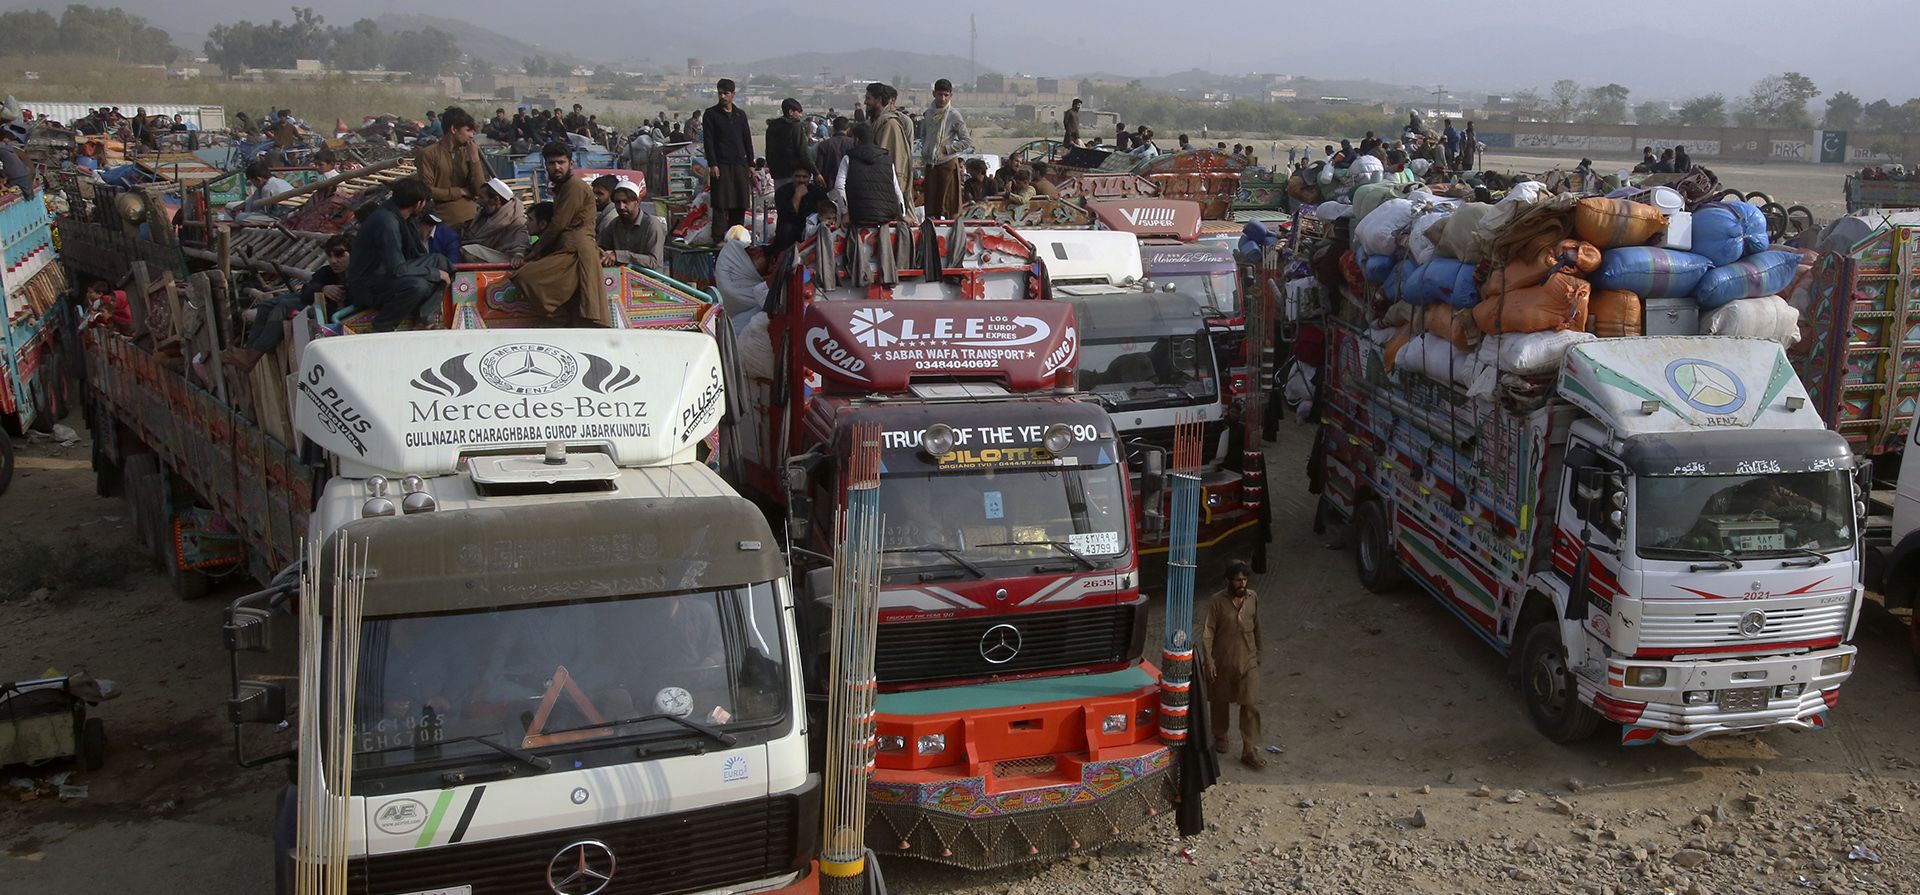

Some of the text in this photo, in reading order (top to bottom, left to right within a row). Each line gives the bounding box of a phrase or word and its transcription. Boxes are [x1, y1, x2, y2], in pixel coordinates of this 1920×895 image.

[494, 344, 560, 358] MERCEDES
[821, 338, 866, 372] ROAD
[885, 349, 1025, 360] SABAR WAFA TRANSPORT
[1045, 340, 1070, 371] KING
[515, 386, 548, 394] BENZ
[682, 384, 712, 427] PLUS
[711, 366, 719, 389] S
[308, 364, 372, 433] S PLUS
[409, 396, 647, 423] Mercedes-Benz
[1707, 417, 1738, 426] BENZ
[406, 429, 466, 447] GULLNAZAR
[469, 425, 542, 443] CHARAGHBABA
[545, 424, 577, 440] GUROP
[881, 430, 927, 448] TRUC
[952, 428, 972, 445] OF
[978, 427, 1014, 444] THE
[1086, 544, 1110, 553] 43799
[1083, 578, 1114, 588] 2635
[1743, 591, 1770, 600] 2021
[723, 768, 744, 778] EURO
